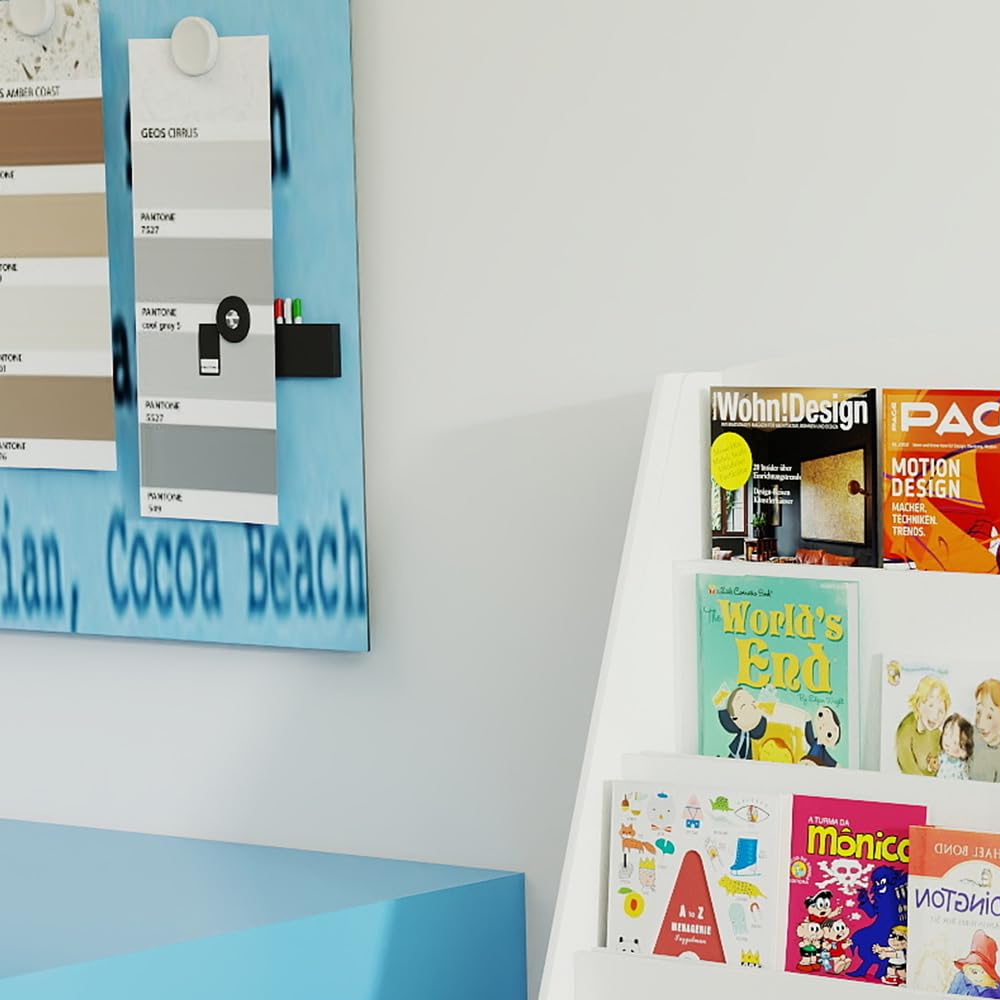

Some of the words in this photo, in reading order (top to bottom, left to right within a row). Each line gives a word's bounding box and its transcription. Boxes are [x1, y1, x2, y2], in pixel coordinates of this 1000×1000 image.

[6, 87, 33, 98] AMBER
[35, 85, 60, 97] COAST
[141, 127, 166, 138] GEOS
[168, 127, 199, 138] CIRRUS
[141, 213, 176, 221] PANTONE
[142, 307, 177, 317] PANTONE
[145, 401, 180, 410] PANTONE
[892, 457, 961, 478] MOTION
[892, 478, 961, 499] DESIGN
[892, 502, 927, 513] MACHER.
[892, 514, 938, 525] TECHNIKEN.
[892, 526, 927, 537] TRENDS.
[107, 509, 223, 620] Cocoa
[247, 493, 366, 621] Beach
[718, 599, 845, 642] World's
[735, 637, 834, 695] End
[814, 816, 839, 825] TURMA
[840, 819, 850, 827] DA
[679, 904, 687, 918] A
[697, 906, 705, 920] Z
